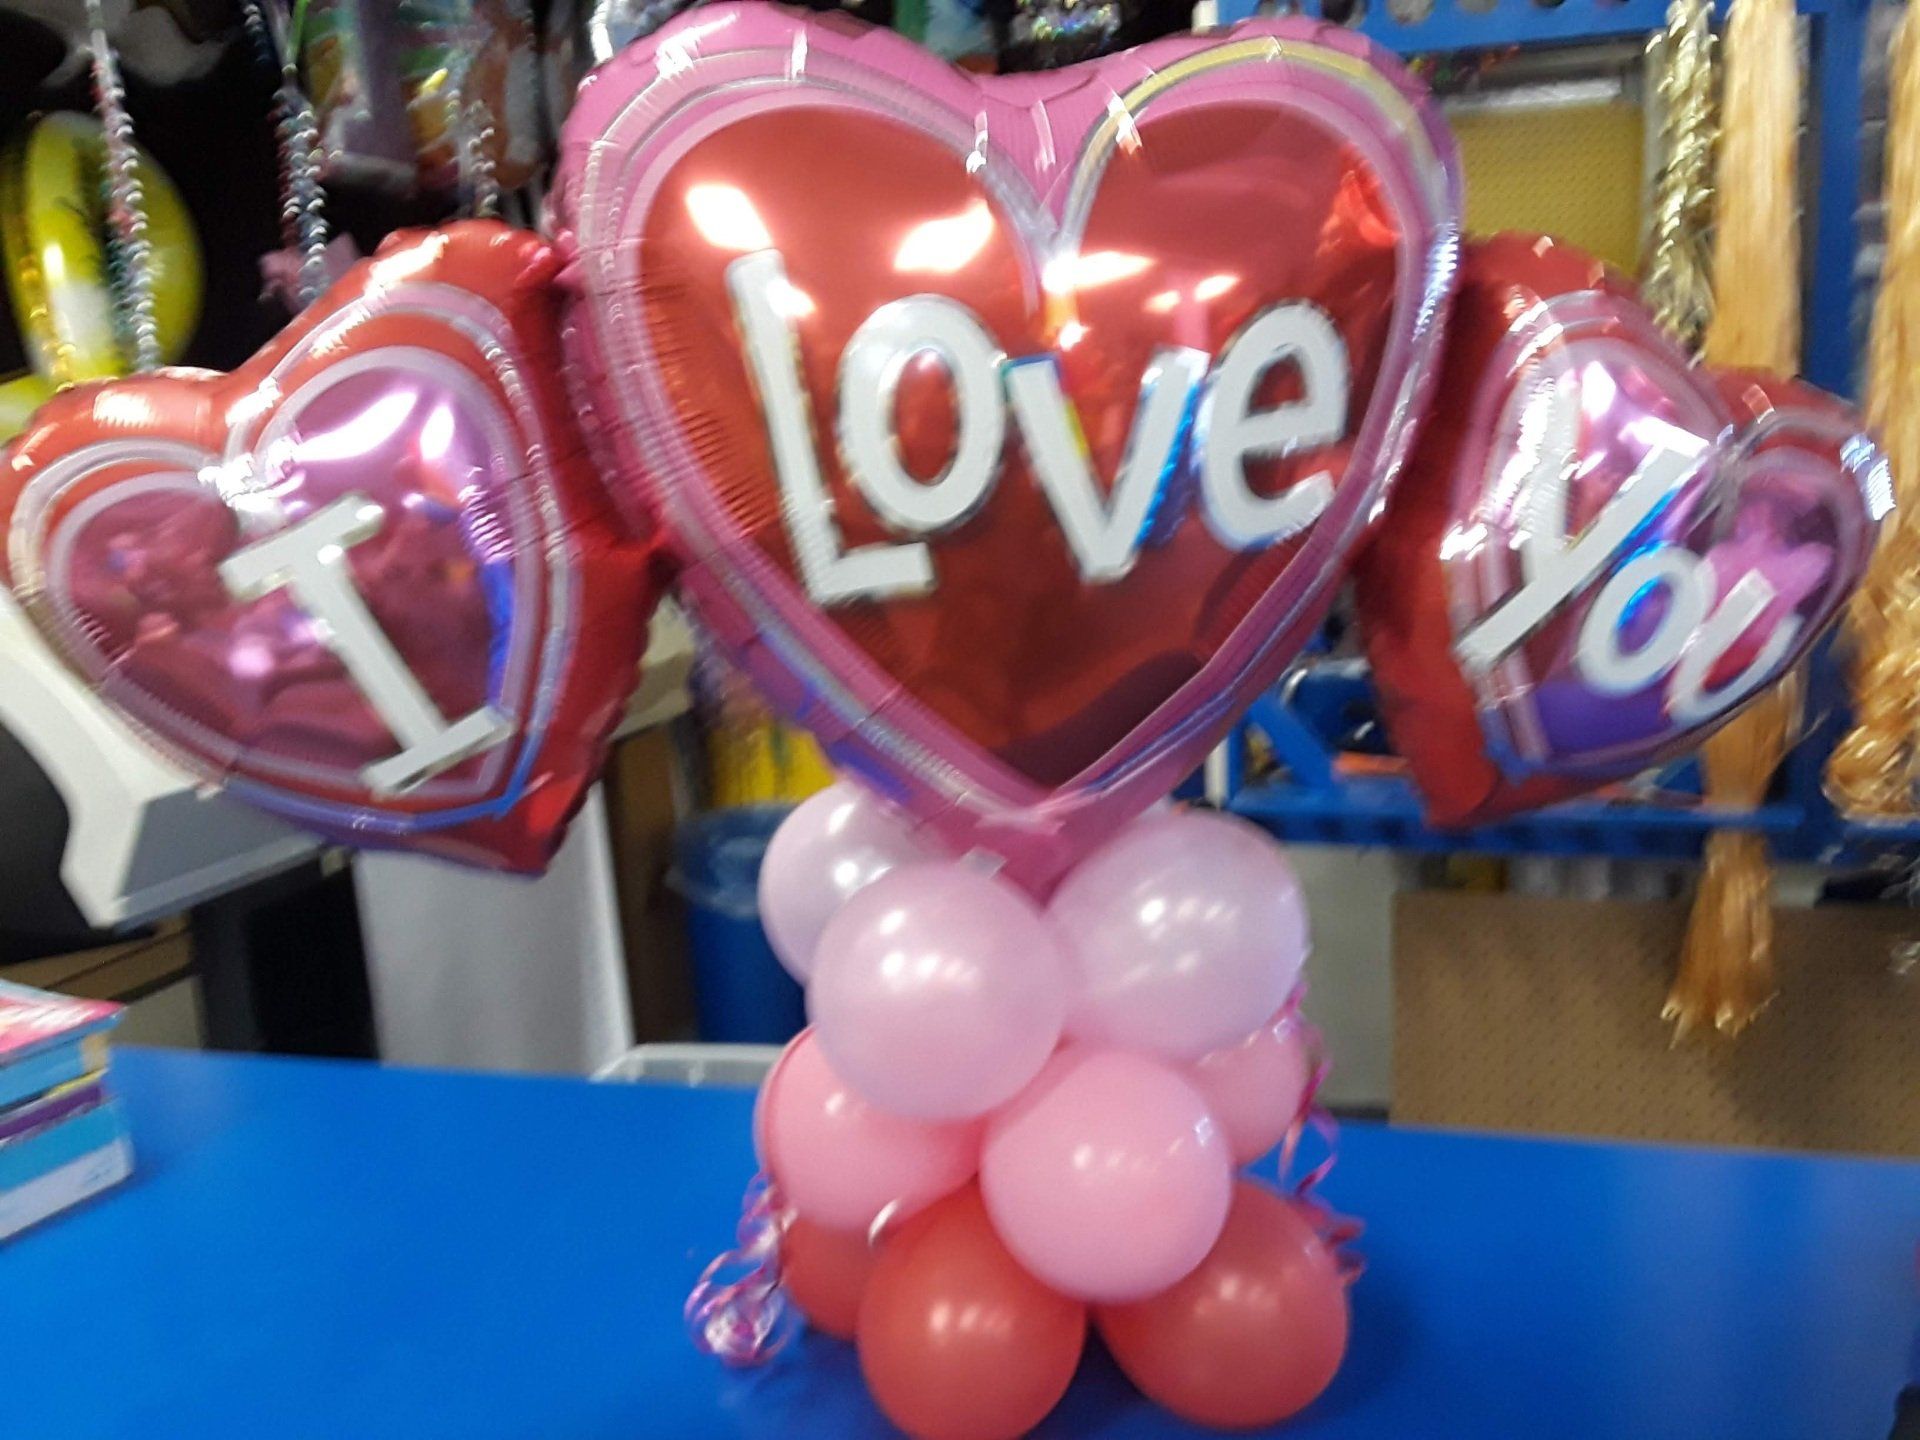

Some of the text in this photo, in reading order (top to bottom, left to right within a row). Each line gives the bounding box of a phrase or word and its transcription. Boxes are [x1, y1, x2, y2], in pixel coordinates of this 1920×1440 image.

[217, 249, 1803, 799] I Love You
